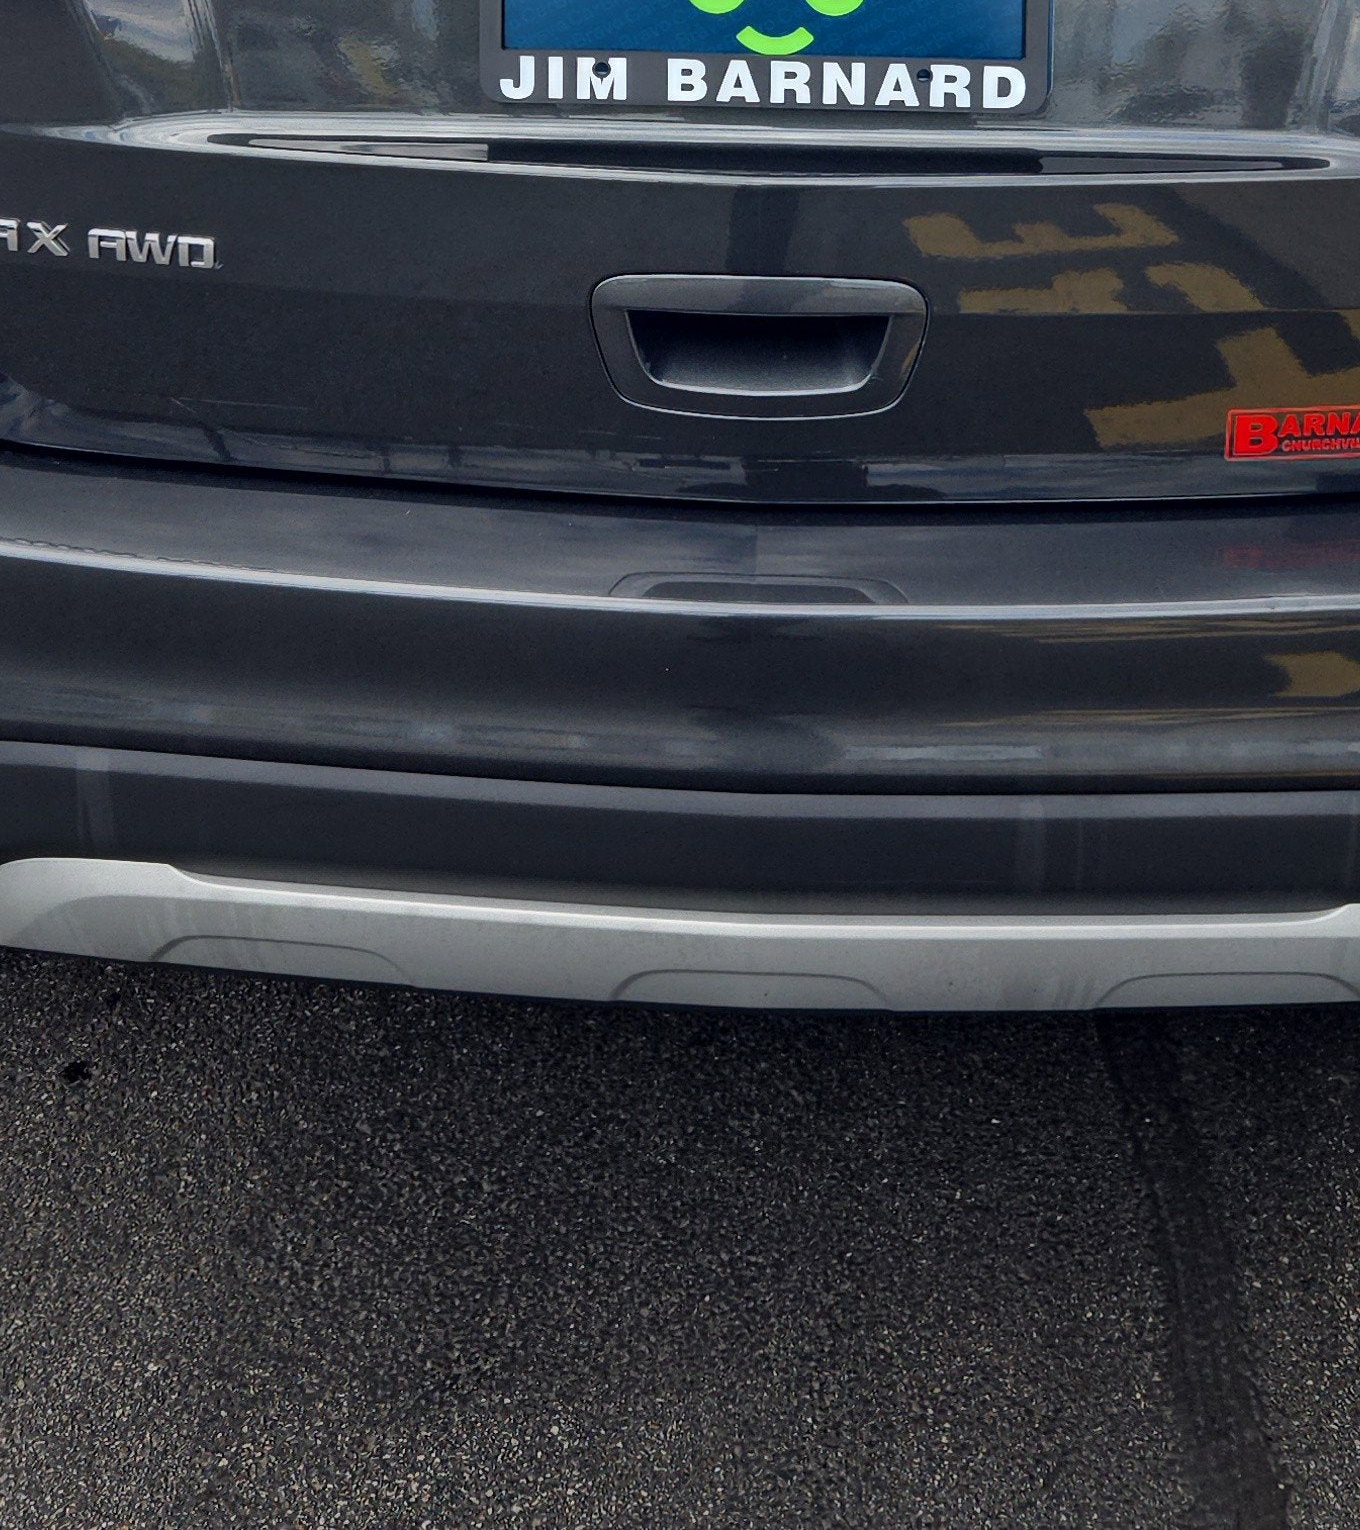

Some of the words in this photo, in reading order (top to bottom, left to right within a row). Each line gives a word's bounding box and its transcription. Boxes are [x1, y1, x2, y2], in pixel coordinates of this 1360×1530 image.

[499, 54, 628, 101] JIM
[666, 59, 1027, 109] BARNARD
[87, 227, 216, 269] AWD
